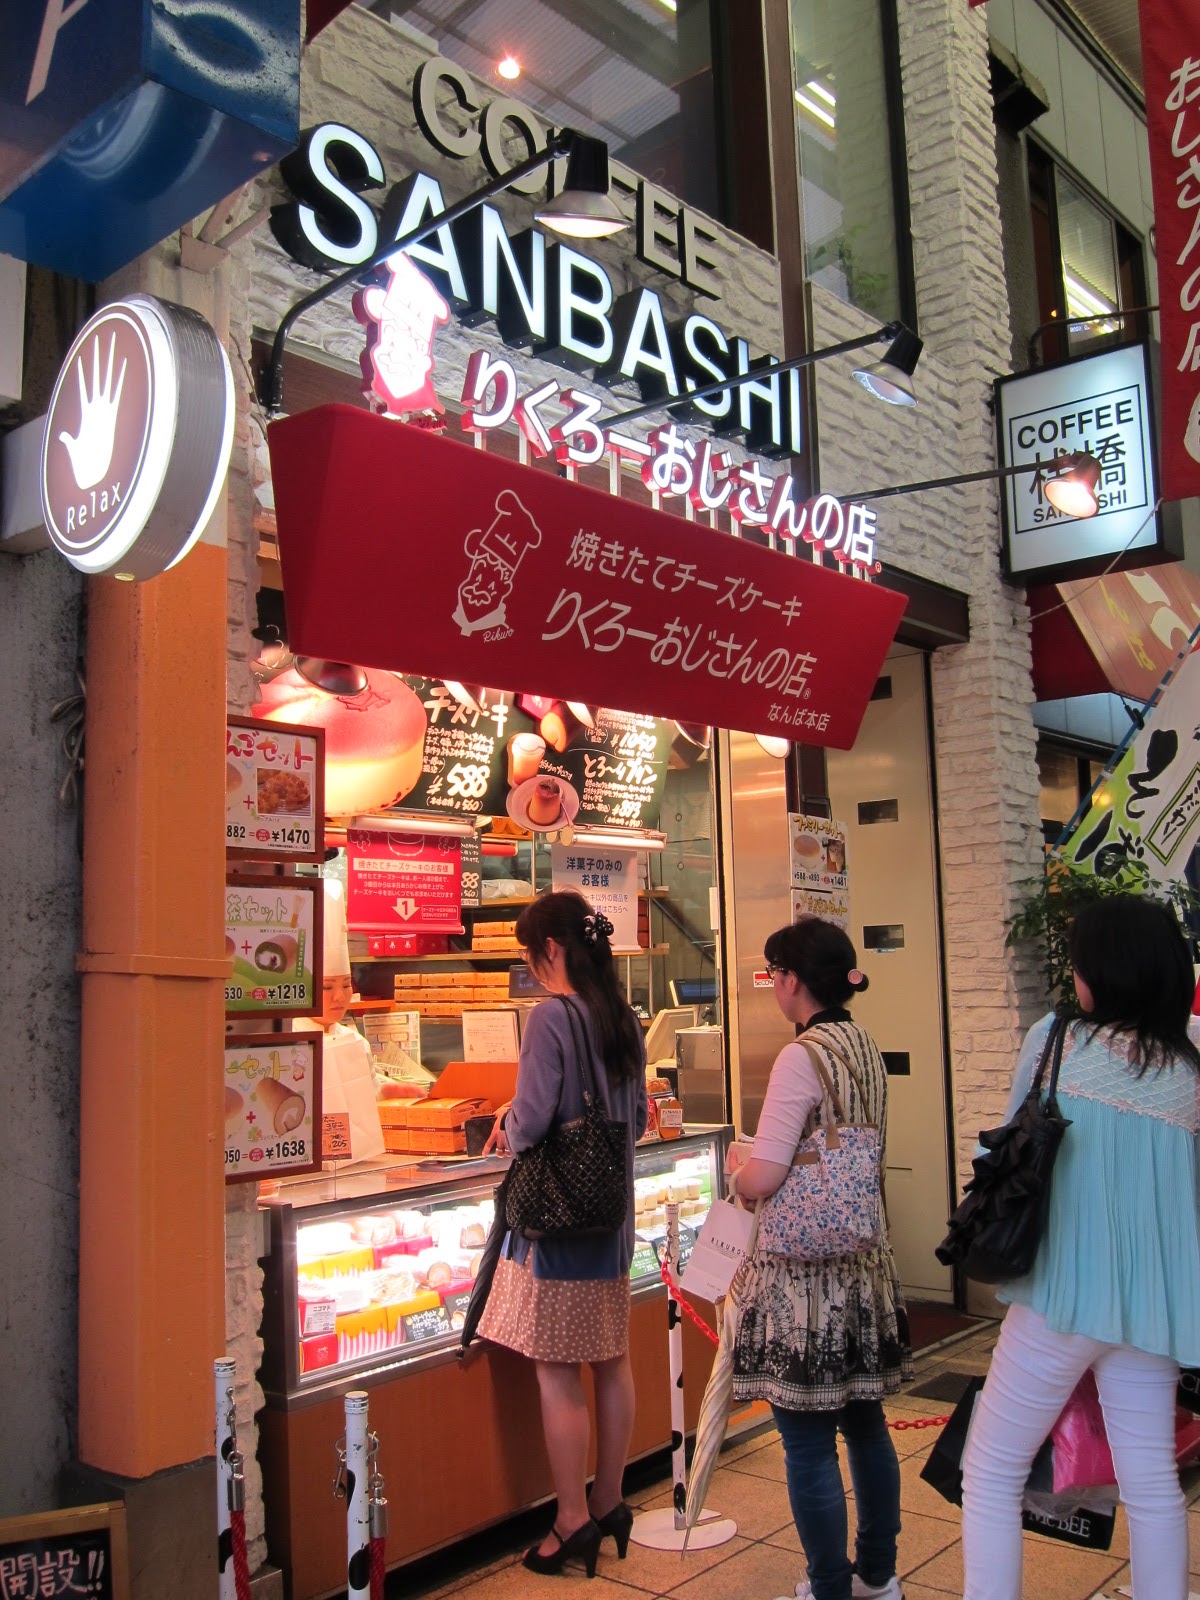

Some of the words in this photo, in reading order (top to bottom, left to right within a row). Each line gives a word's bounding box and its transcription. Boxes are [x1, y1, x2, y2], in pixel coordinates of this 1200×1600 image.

[413, 57, 721, 300] COEE
[298, 121, 802, 456] SANBASHI
[1017, 399, 1134, 449] COFFEE
[470, 349, 879, 567] りくろーおじさんの店
[66, 482, 123, 534] Relax
[1033, 489, 1127, 523] SASHI
[566, 528, 803, 626] 焼きたてチーズケーキ
[541, 588, 818, 698] りくろーおじさんの店
[767, 702, 831, 732] なんば本店
[1161, 778, 1200, 846] だわり
[226, 825, 246, 839] 882
[271, 828, 310, 845] ¥1470
[358, 860, 449, 873] 焼きたてチーズケーキのお客様
[566, 856, 623, 872] 洋菓子のみの
[581, 873, 610, 888] お客様
[227, 893, 288, 923] 茶セット
[401, 900, 409, 916] 1
[225, 986, 243, 1000] 630
[267, 984, 306, 1000] ¥1218
[265, 1139, 306, 1160] ¥1638
